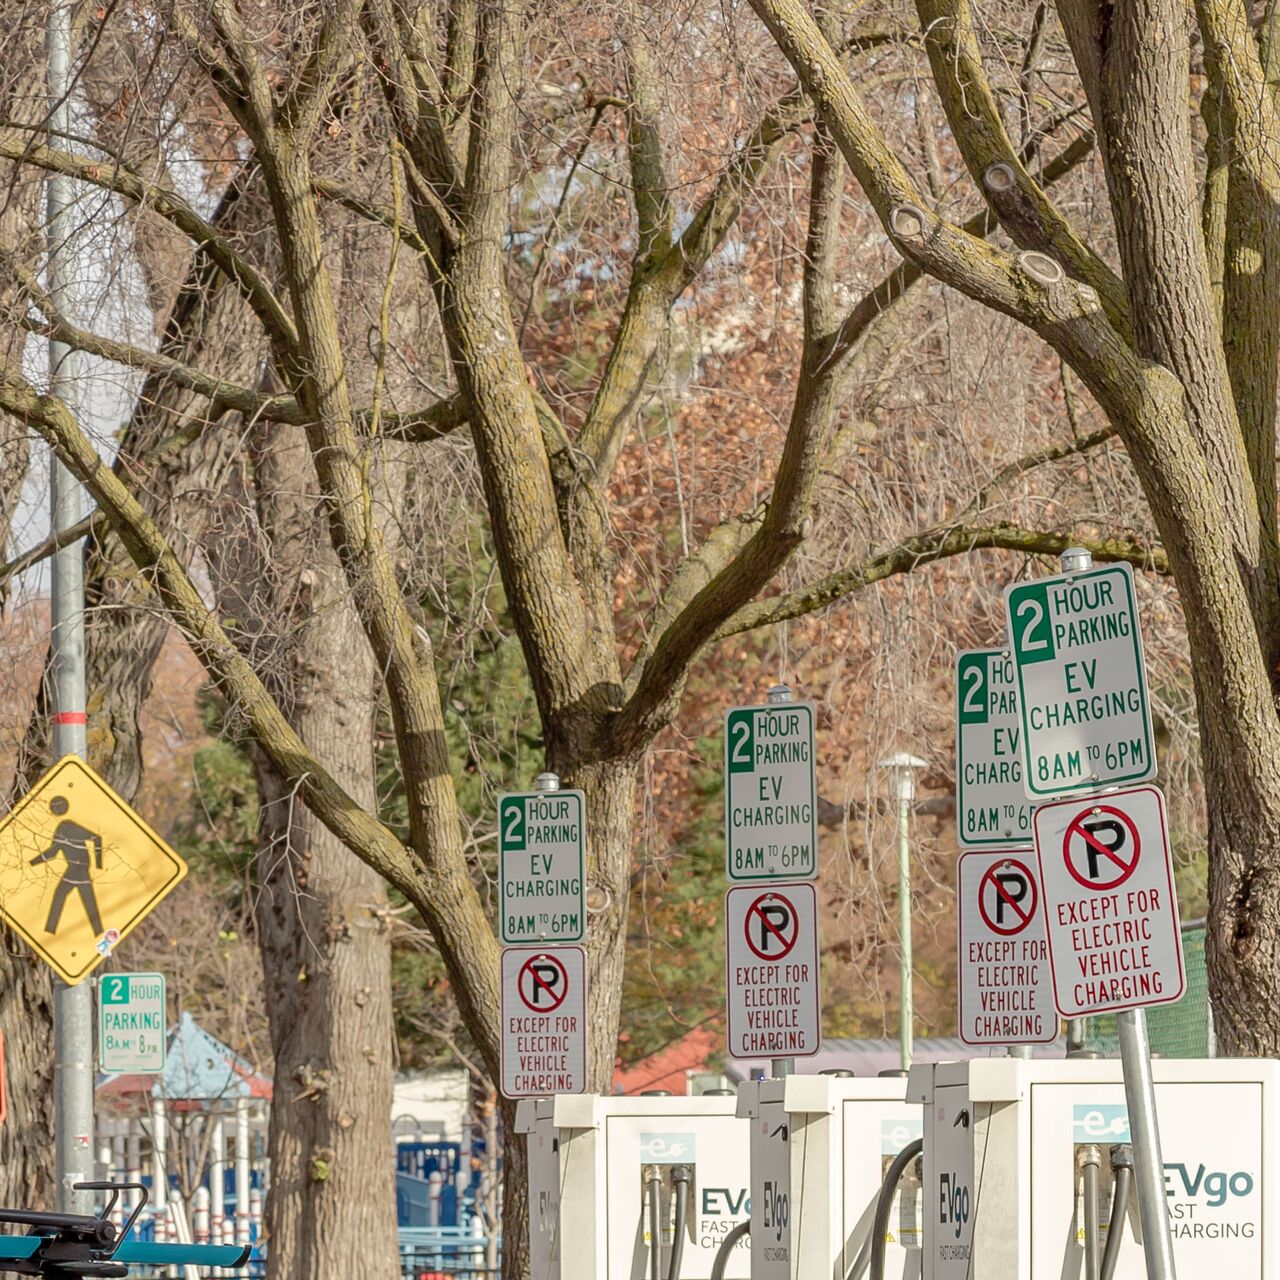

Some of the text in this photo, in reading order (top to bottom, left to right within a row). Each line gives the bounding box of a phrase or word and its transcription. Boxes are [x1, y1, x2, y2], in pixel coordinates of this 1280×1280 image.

[1017, 580, 1113, 652] 2 HOUR
[1055, 611, 1129, 649] PARKING
[963, 661, 1014, 713] 2 HO
[1065, 659, 1097, 693] EV
[1031, 689, 1140, 730] CHARGING
[732, 715, 799, 763] 2 HOUR
[994, 728, 1019, 755] EV
[757, 741, 808, 764] PARKING
[1038, 738, 1143, 782] 8AM TO 6PM
[965, 761, 1021, 785] CHARG
[760, 776, 782, 801] EV
[505, 802, 568, 842] 2 HOUR
[734, 805, 810, 827] CHARGING
[968, 809, 998, 832] 8AM
[1004, 805, 1014, 818] TO
[528, 825, 577, 844] PARKING
[531, 854, 552, 875] EV
[736, 845, 809, 869] 8AM TO 6PM
[506, 879, 579, 898] CHARGING
[1057, 889, 1160, 926] EXCEPT FOR
[509, 914, 578, 934] 8AM TO 6PM
[1072, 918, 1151, 951] ELECTRIC
[970, 941, 1016, 962] EXCEPT
[1078, 946, 1151, 977] VEHICLE
[737, 965, 808, 985] EXCEPT FOR
[978, 965, 1038, 987] ELECTRIC
[110, 979, 160, 1000] 2 HOUR
[745, 987, 800, 1007] ELECTRIC
[1075, 972, 1163, 1006] CHARGING
[981, 990, 1035, 1012] VEHICLE
[105, 1012, 160, 1030] PARKING
[510, 1017, 576, 1033] EXCEPT FOR
[747, 1009, 798, 1028] VEHICLE
[975, 1015, 1042, 1037] CHARGING
[518, 1036, 569, 1052] ELECTRIC
[743, 1031, 805, 1051] CHARGING
[520, 1055, 566, 1071] VEHICLE
[515, 1074, 572, 1091] CHARGING
[1163, 1163, 1254, 1207] EVgo
[702, 1188, 751, 1215] EV
[764, 1181, 788, 1242] EVgo
[940, 1172, 969, 1239] EVgo
[1170, 1223, 1255, 1239] HARGING
